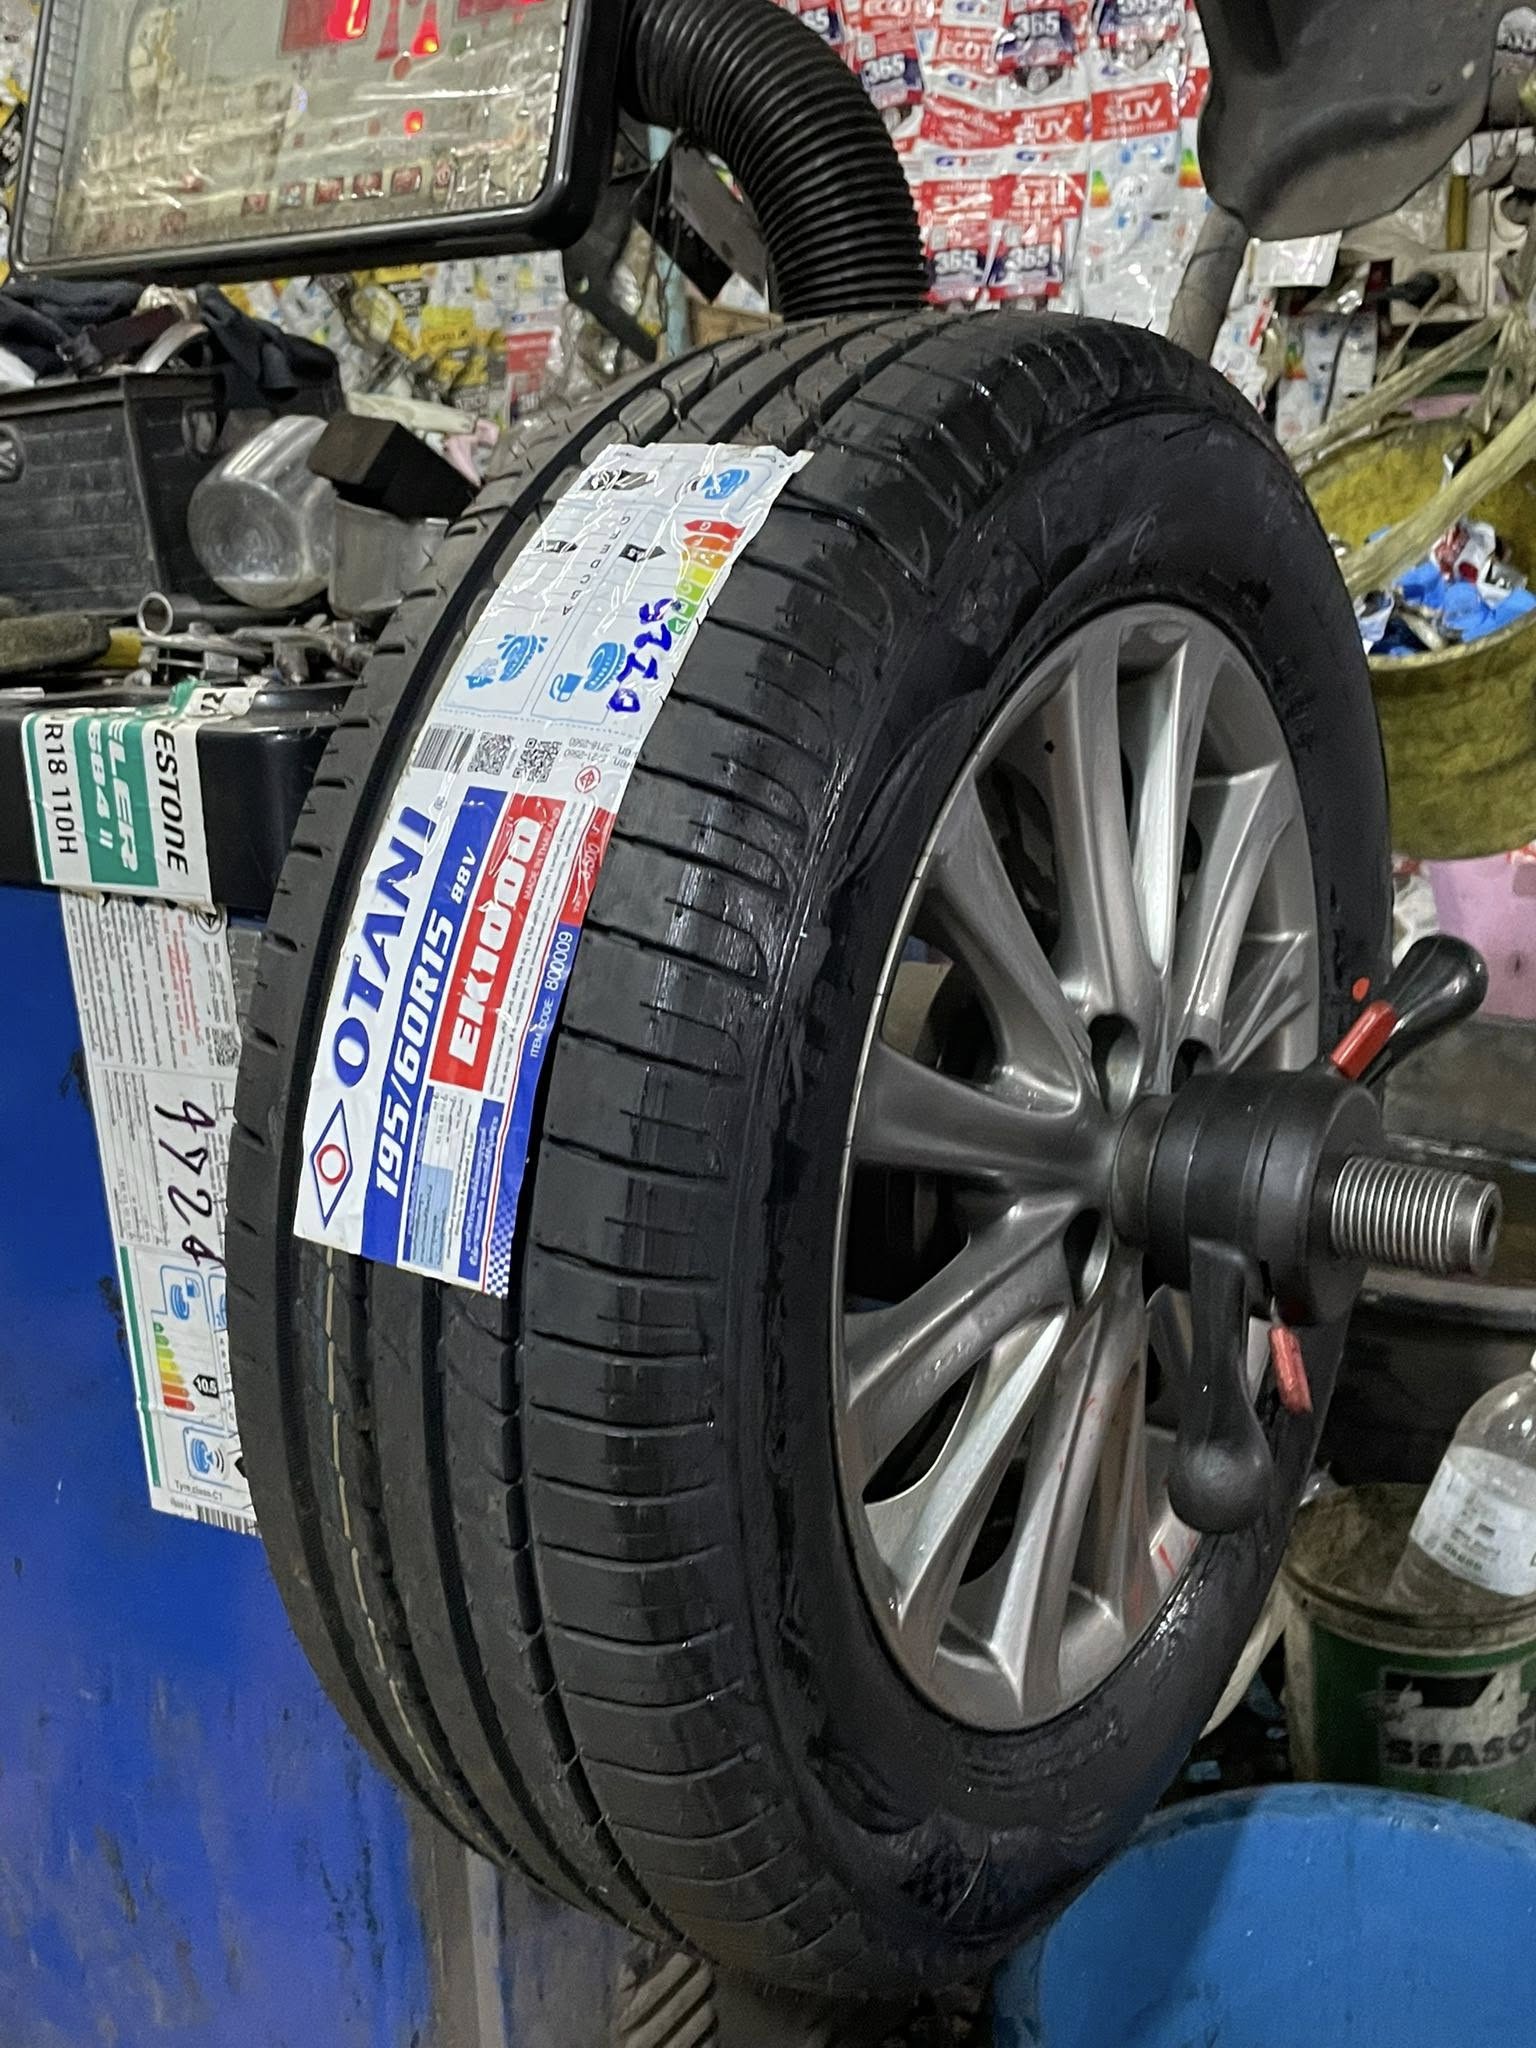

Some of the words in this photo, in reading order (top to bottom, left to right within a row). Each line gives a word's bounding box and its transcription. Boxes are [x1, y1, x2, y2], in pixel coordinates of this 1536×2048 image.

[1012, 10, 1061, 41] 365
[863, 53, 905, 84] 365
[934, 249, 978, 275] 365
[1004, 244, 1051, 272] 365
[44, 722, 68, 774] R18
[52, 786, 78, 854] 110H
[523, 871, 540, 900] MADE
[334, 806, 437, 1088] OTANI
[448, 816, 543, 1067] EK1000
[527, 1033, 544, 1058] ITEM
[544, 931, 574, 991] 800009
[376, 909, 454, 1198] 195/60R15
[451, 846, 477, 904] 88V
[196, 1377, 218, 1396] 10.5
